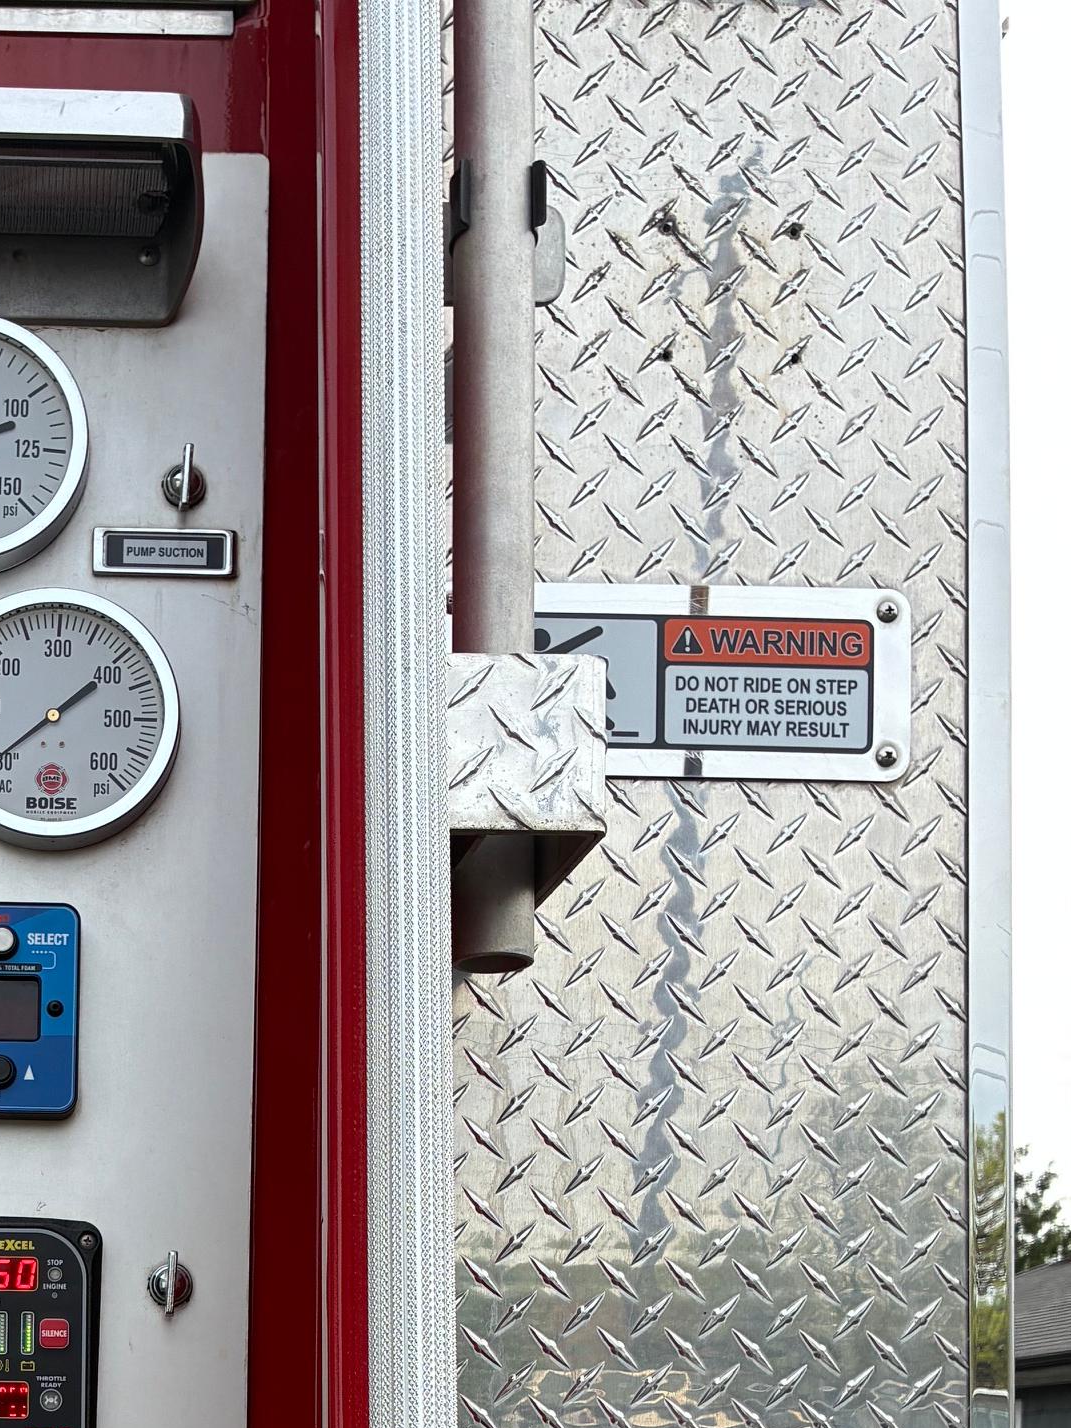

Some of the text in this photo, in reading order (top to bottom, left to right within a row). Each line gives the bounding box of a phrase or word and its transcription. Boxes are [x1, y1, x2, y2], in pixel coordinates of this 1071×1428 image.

[3, 399, 29, 418] 100
[15, 440, 40, 458] 125
[3, 503, 18, 518] psi
[126, 545, 204, 558] PUMP SUCTION
[44, 640, 72, 657] 300
[710, 628, 863, 657] WARNING
[93, 666, 121, 684] 400
[676, 676, 858, 696] DO NOT RIDE ON STEP
[686, 698, 847, 716] DEATH OR SERIOUS
[104, 710, 131, 728] 500
[683, 719, 850, 738] INJURY MAY RESULT
[90, 753, 118, 770] 600
[93, 781, 109, 797] psi
[26, 797, 77, 809] BOISE
[27, 933, 69, 945] SELECT
[41, 1329, 67, 1337] SILENCE
